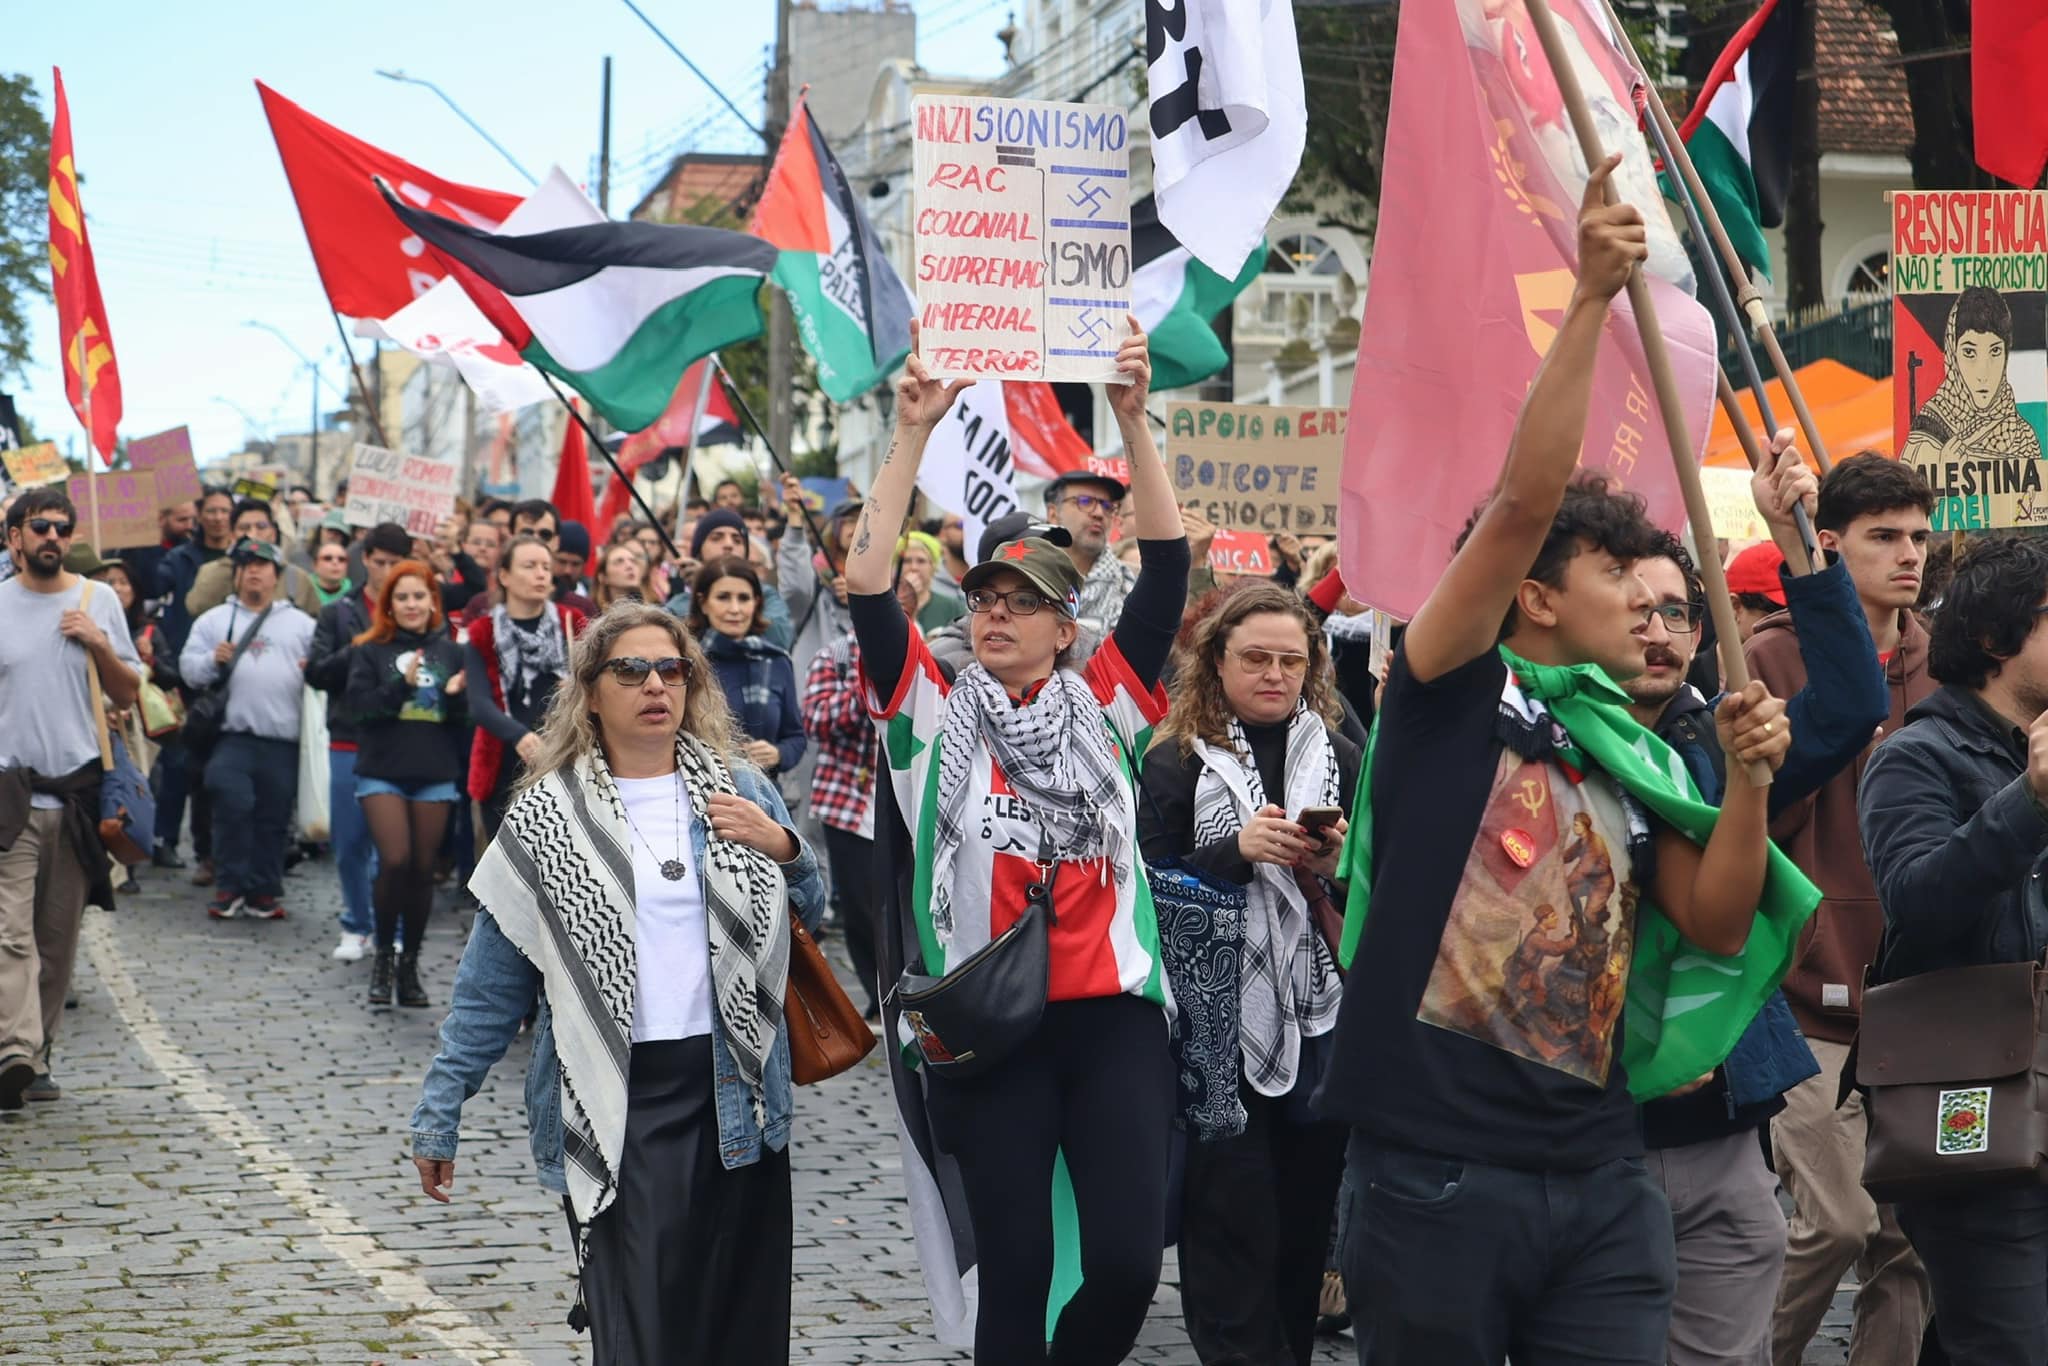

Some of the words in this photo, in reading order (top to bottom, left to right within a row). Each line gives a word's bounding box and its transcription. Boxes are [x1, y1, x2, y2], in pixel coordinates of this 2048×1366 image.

[927, 162, 1007, 193] RAC
[916, 207, 1038, 242] COLONIAL
[1894, 192, 2048, 255] RESISTENCIA
[917, 253, 1045, 290] SUPREMAC
[1050, 240, 1129, 290] ISMO
[1895, 254, 1929, 292] NÃO
[1934, 253, 1944, 291] É
[1951, 254, 2046, 290] TERRORISMO
[921, 302, 1037, 333] IMPERIAL
[926, 346, 1040, 374] TERROR
[1172, 408, 1264, 440] APOIO
[1274, 415, 1291, 438] A
[1174, 454, 1318, 494] BOICOTE
